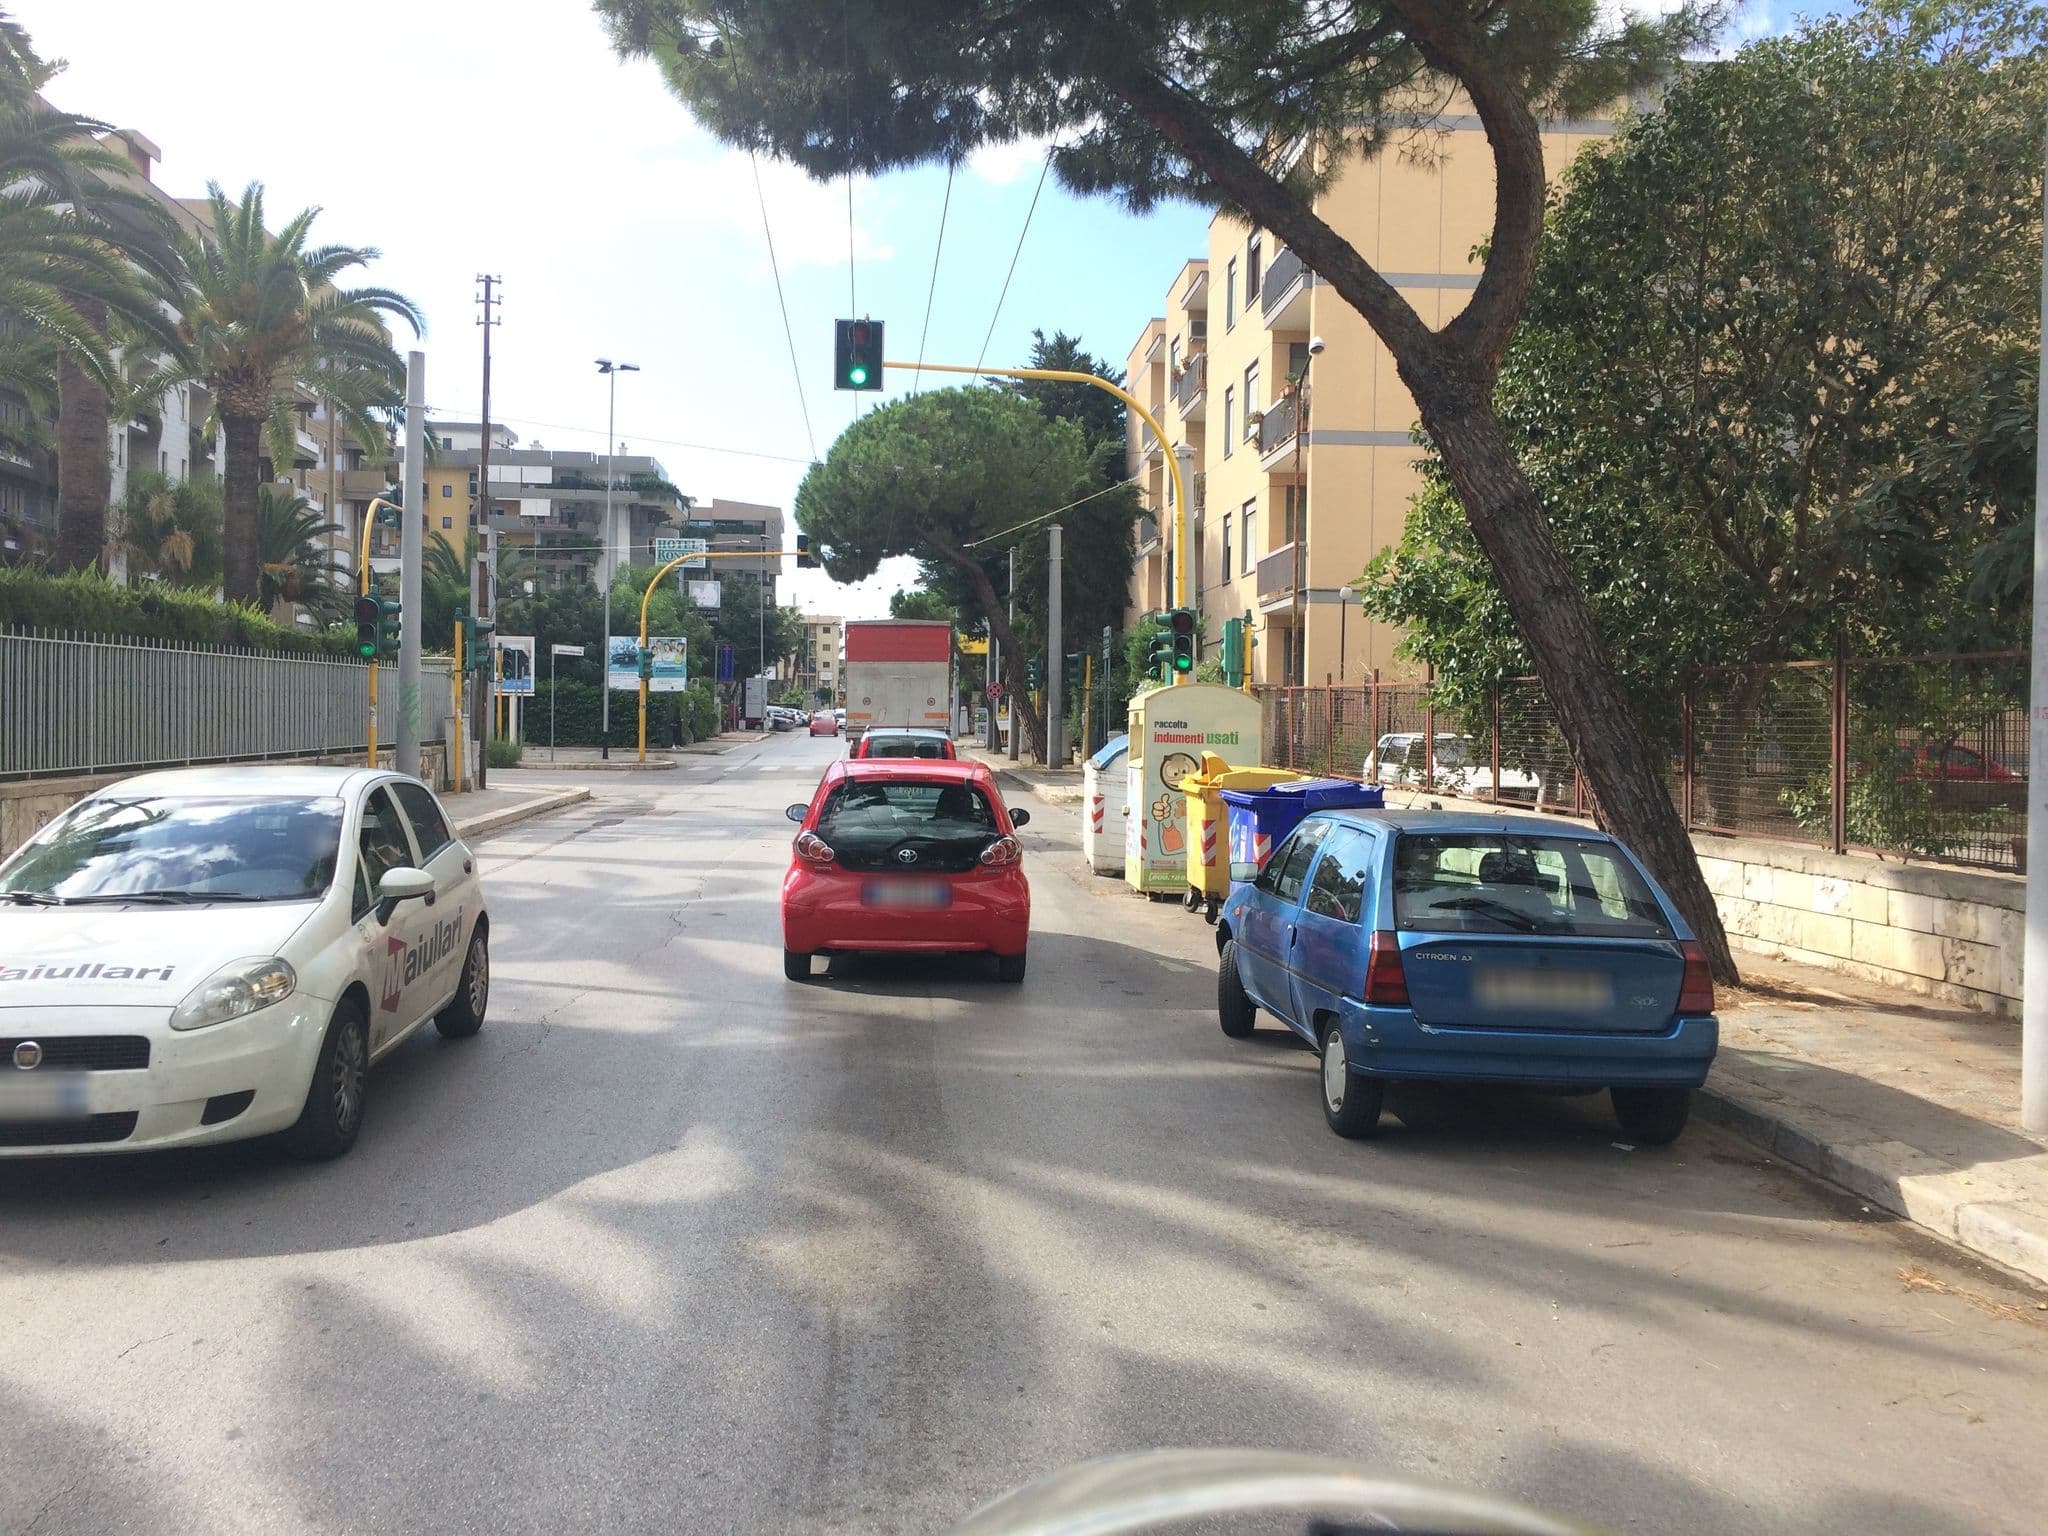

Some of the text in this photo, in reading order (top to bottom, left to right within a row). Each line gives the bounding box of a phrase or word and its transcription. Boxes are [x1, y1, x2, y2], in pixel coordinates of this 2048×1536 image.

[658, 539, 698, 549] HOTEL
[1154, 720, 1188, 729] raccolta
[1154, 732, 1239, 745] indumenti usati
[381, 905, 462, 1013] Maiullari
[0, 963, 176, 982] aiullari
